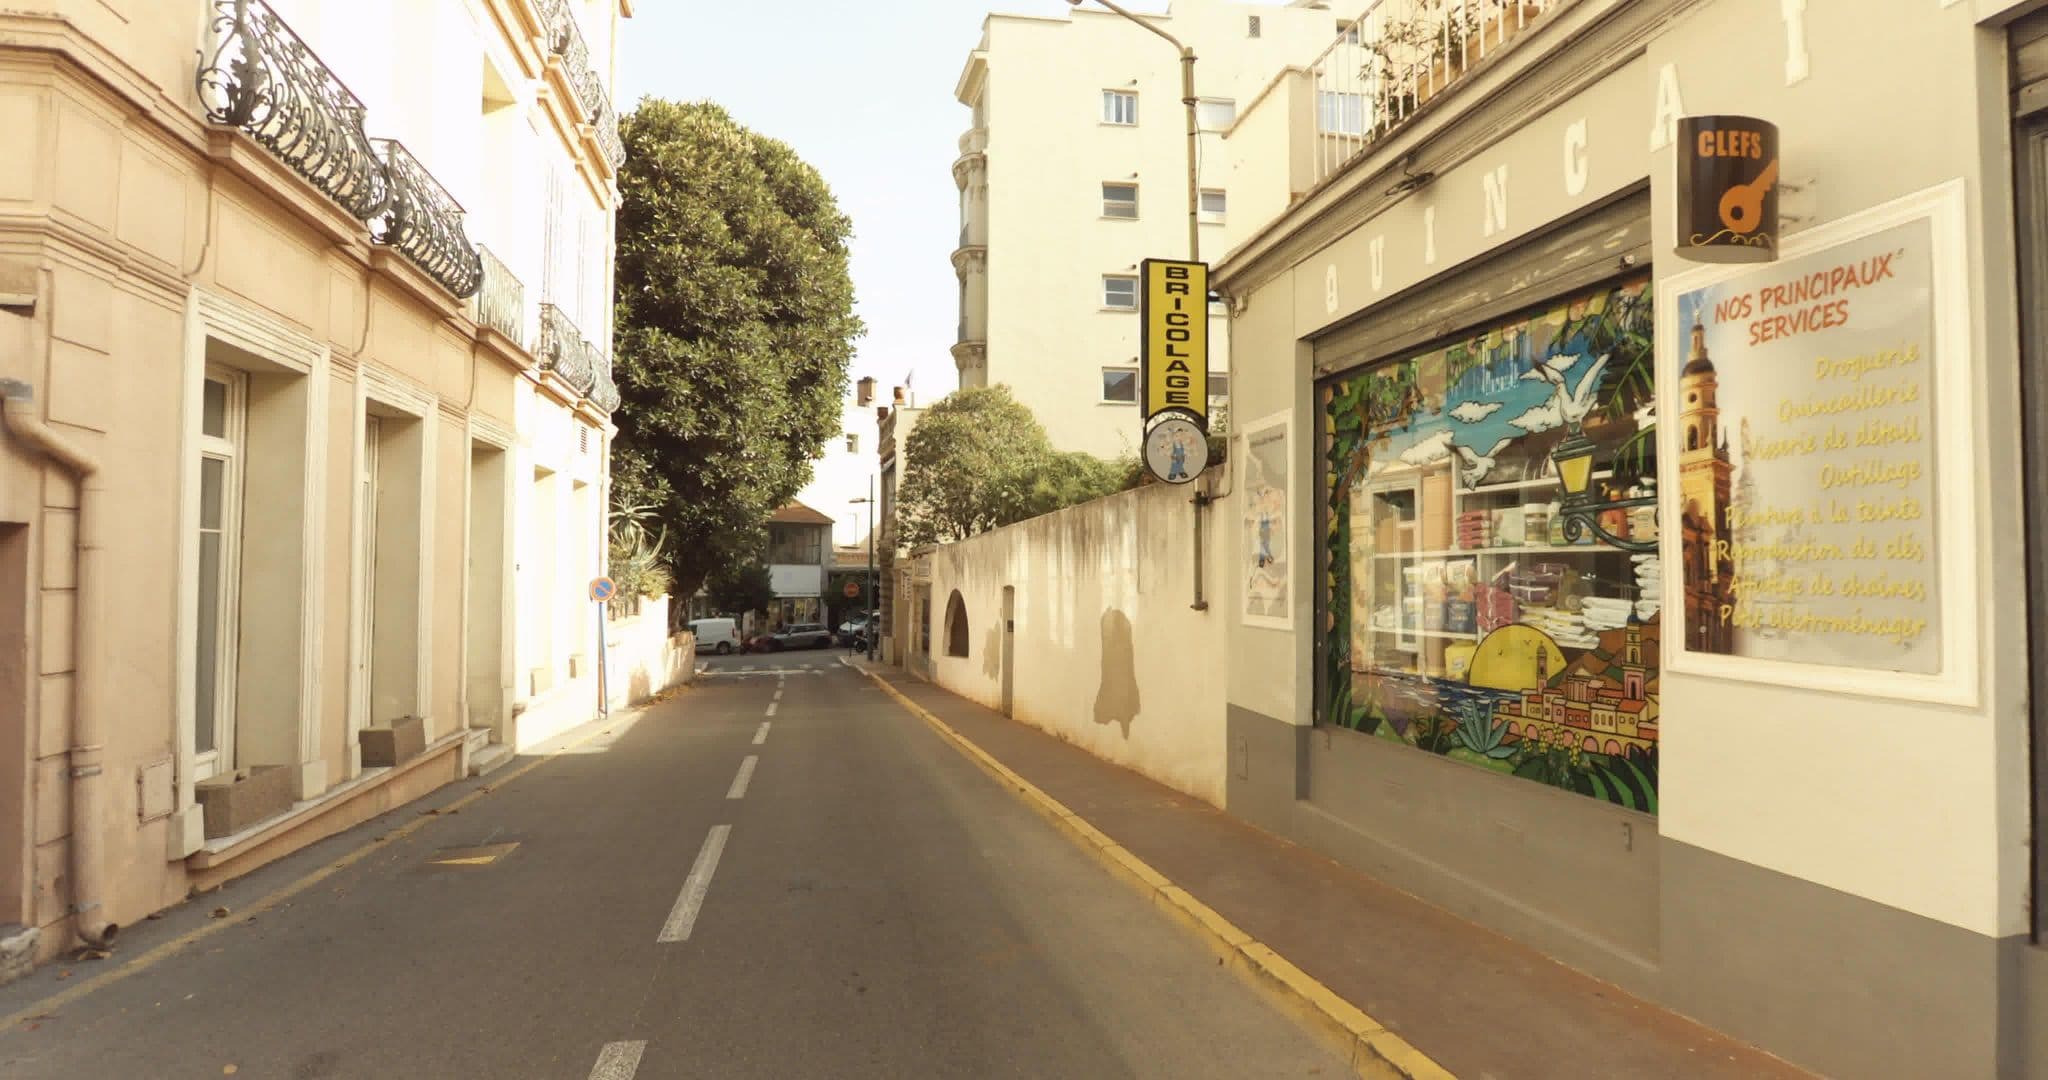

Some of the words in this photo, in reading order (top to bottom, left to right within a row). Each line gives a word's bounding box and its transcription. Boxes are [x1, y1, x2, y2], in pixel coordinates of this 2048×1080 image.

[1698, 129, 1761, 159] CLEFS
[1714, 294, 1752, 324] NOS
[1760, 253, 1894, 313] PRINCIPAUX
[1165, 266, 1190, 405] BRICOLAGE
[1749, 300, 1849, 347] SERVICES
[1815, 339, 1920, 382] Droguerie
[1778, 378, 1919, 426] Quincaillerie
[1823, 424, 1849, 450] de
[1819, 458, 1921, 490] Outillage
[1831, 497, 1851, 525] la
[1856, 496, 1922, 523] teinte
[1850, 535, 1878, 560] de
[1809, 569, 1834, 596] de
